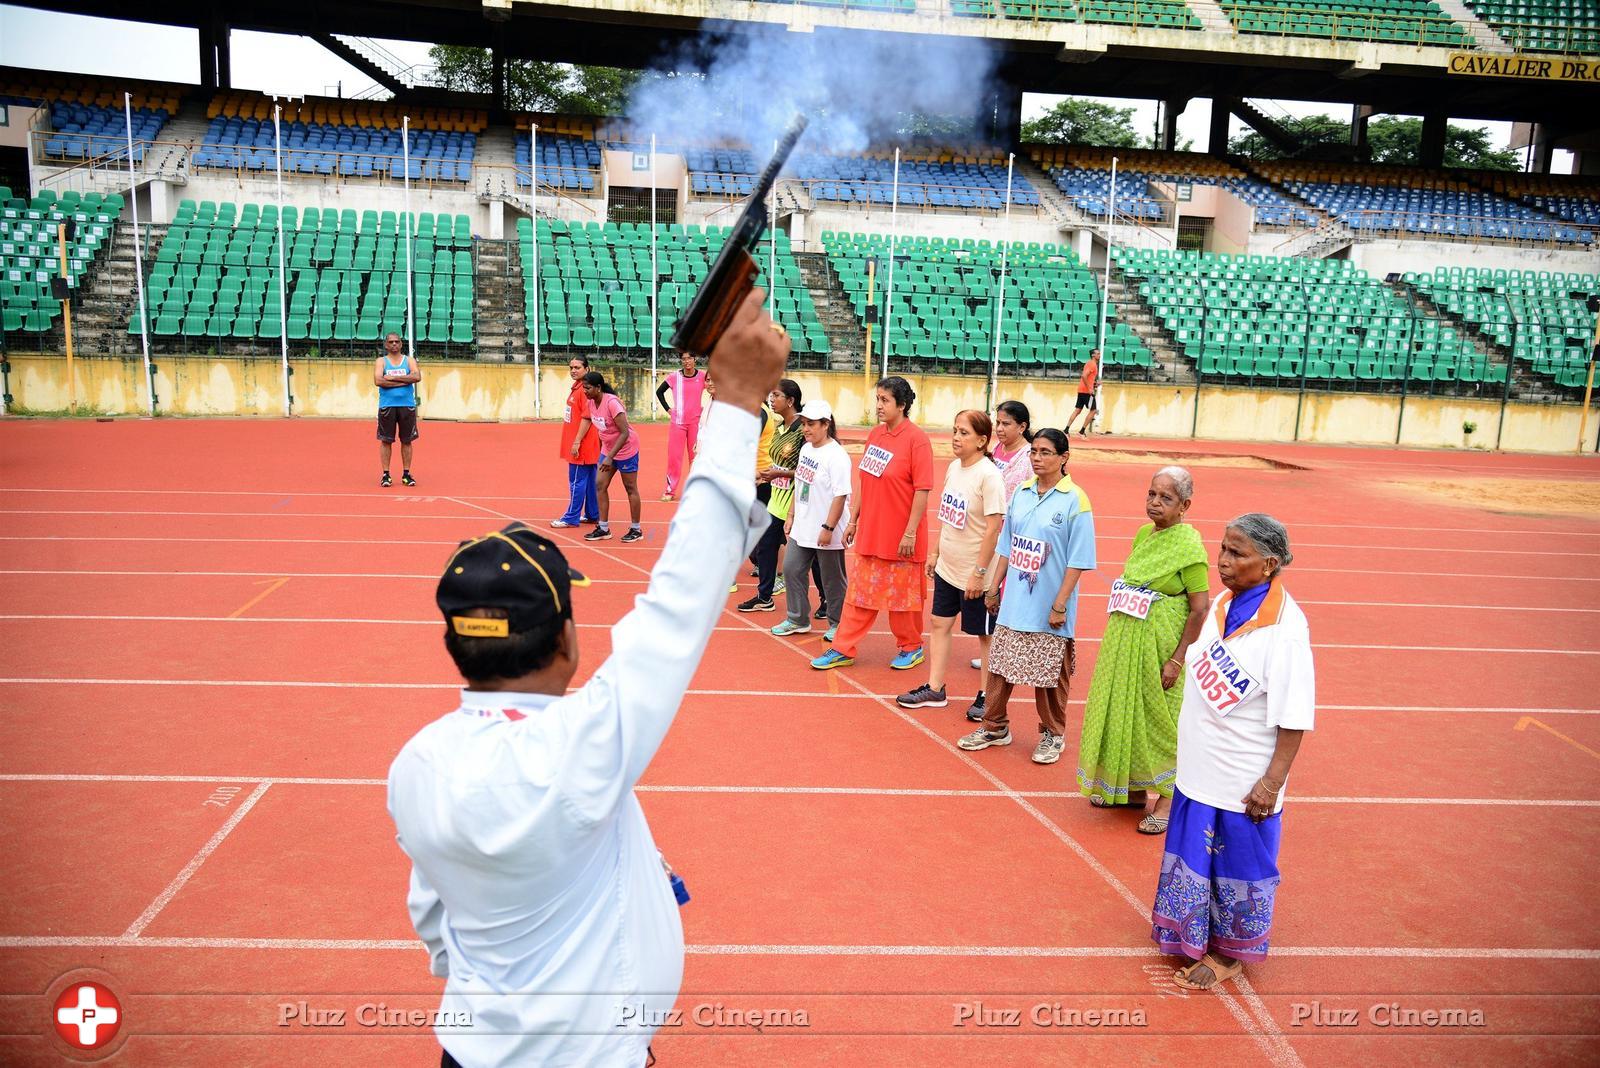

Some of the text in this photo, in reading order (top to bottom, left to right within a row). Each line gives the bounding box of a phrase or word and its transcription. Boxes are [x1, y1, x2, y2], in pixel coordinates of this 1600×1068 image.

[1451, 56, 1552, 77] CAVALIER
[1109, 593, 1149, 615] 70056
[1193, 651, 1240, 710] 70057
[1210, 640, 1250, 694] CDMAA
